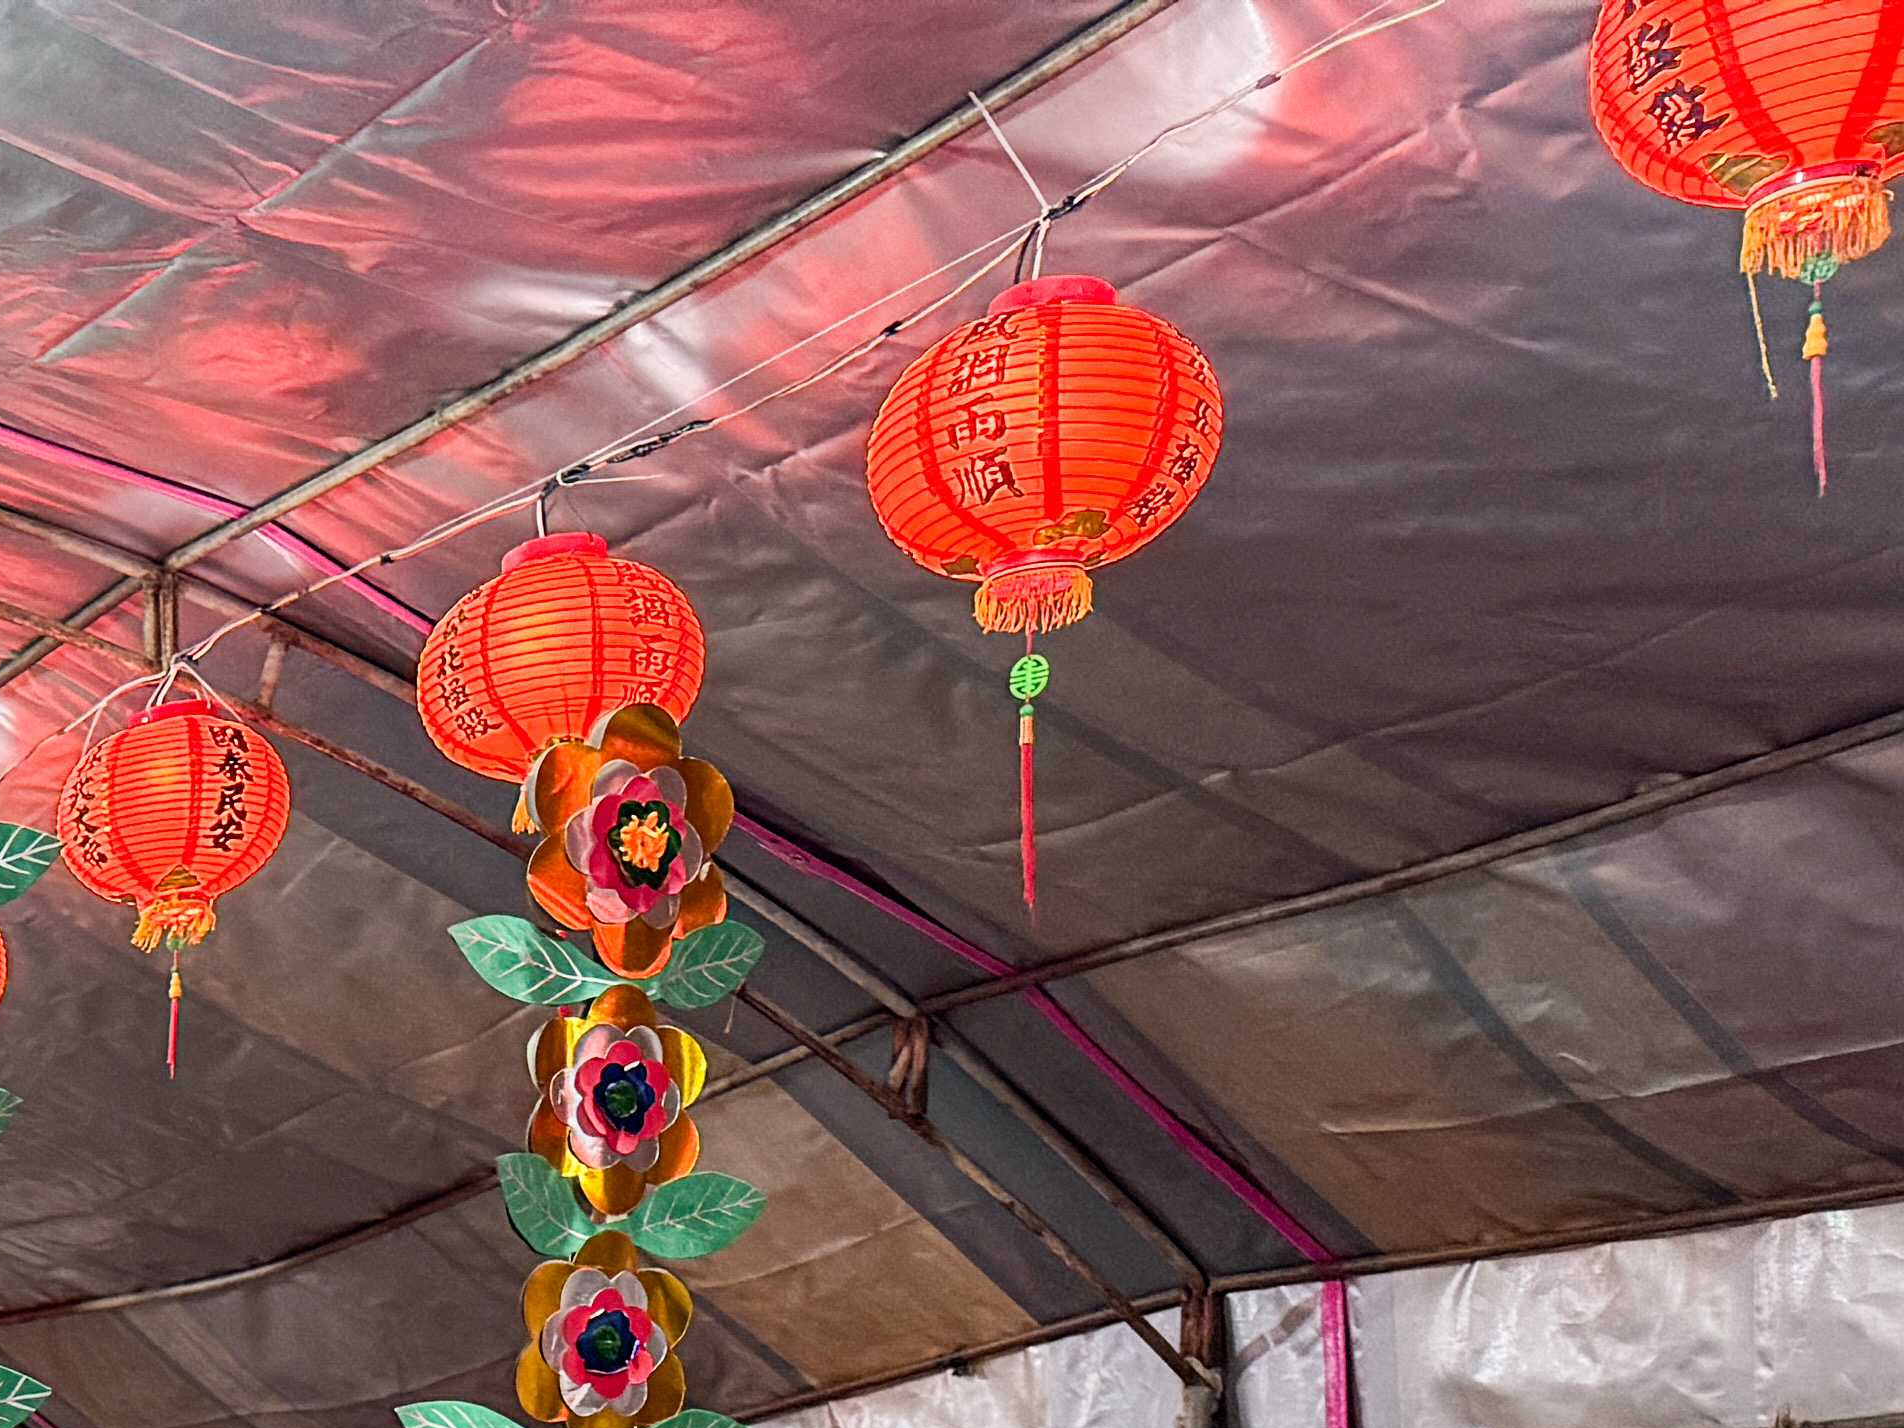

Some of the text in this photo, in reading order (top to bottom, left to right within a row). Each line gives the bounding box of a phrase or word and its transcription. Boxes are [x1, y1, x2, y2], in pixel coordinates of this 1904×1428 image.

[947, 308, 1026, 508] 風調雨順
[201, 725, 254, 853] 國泰民安
